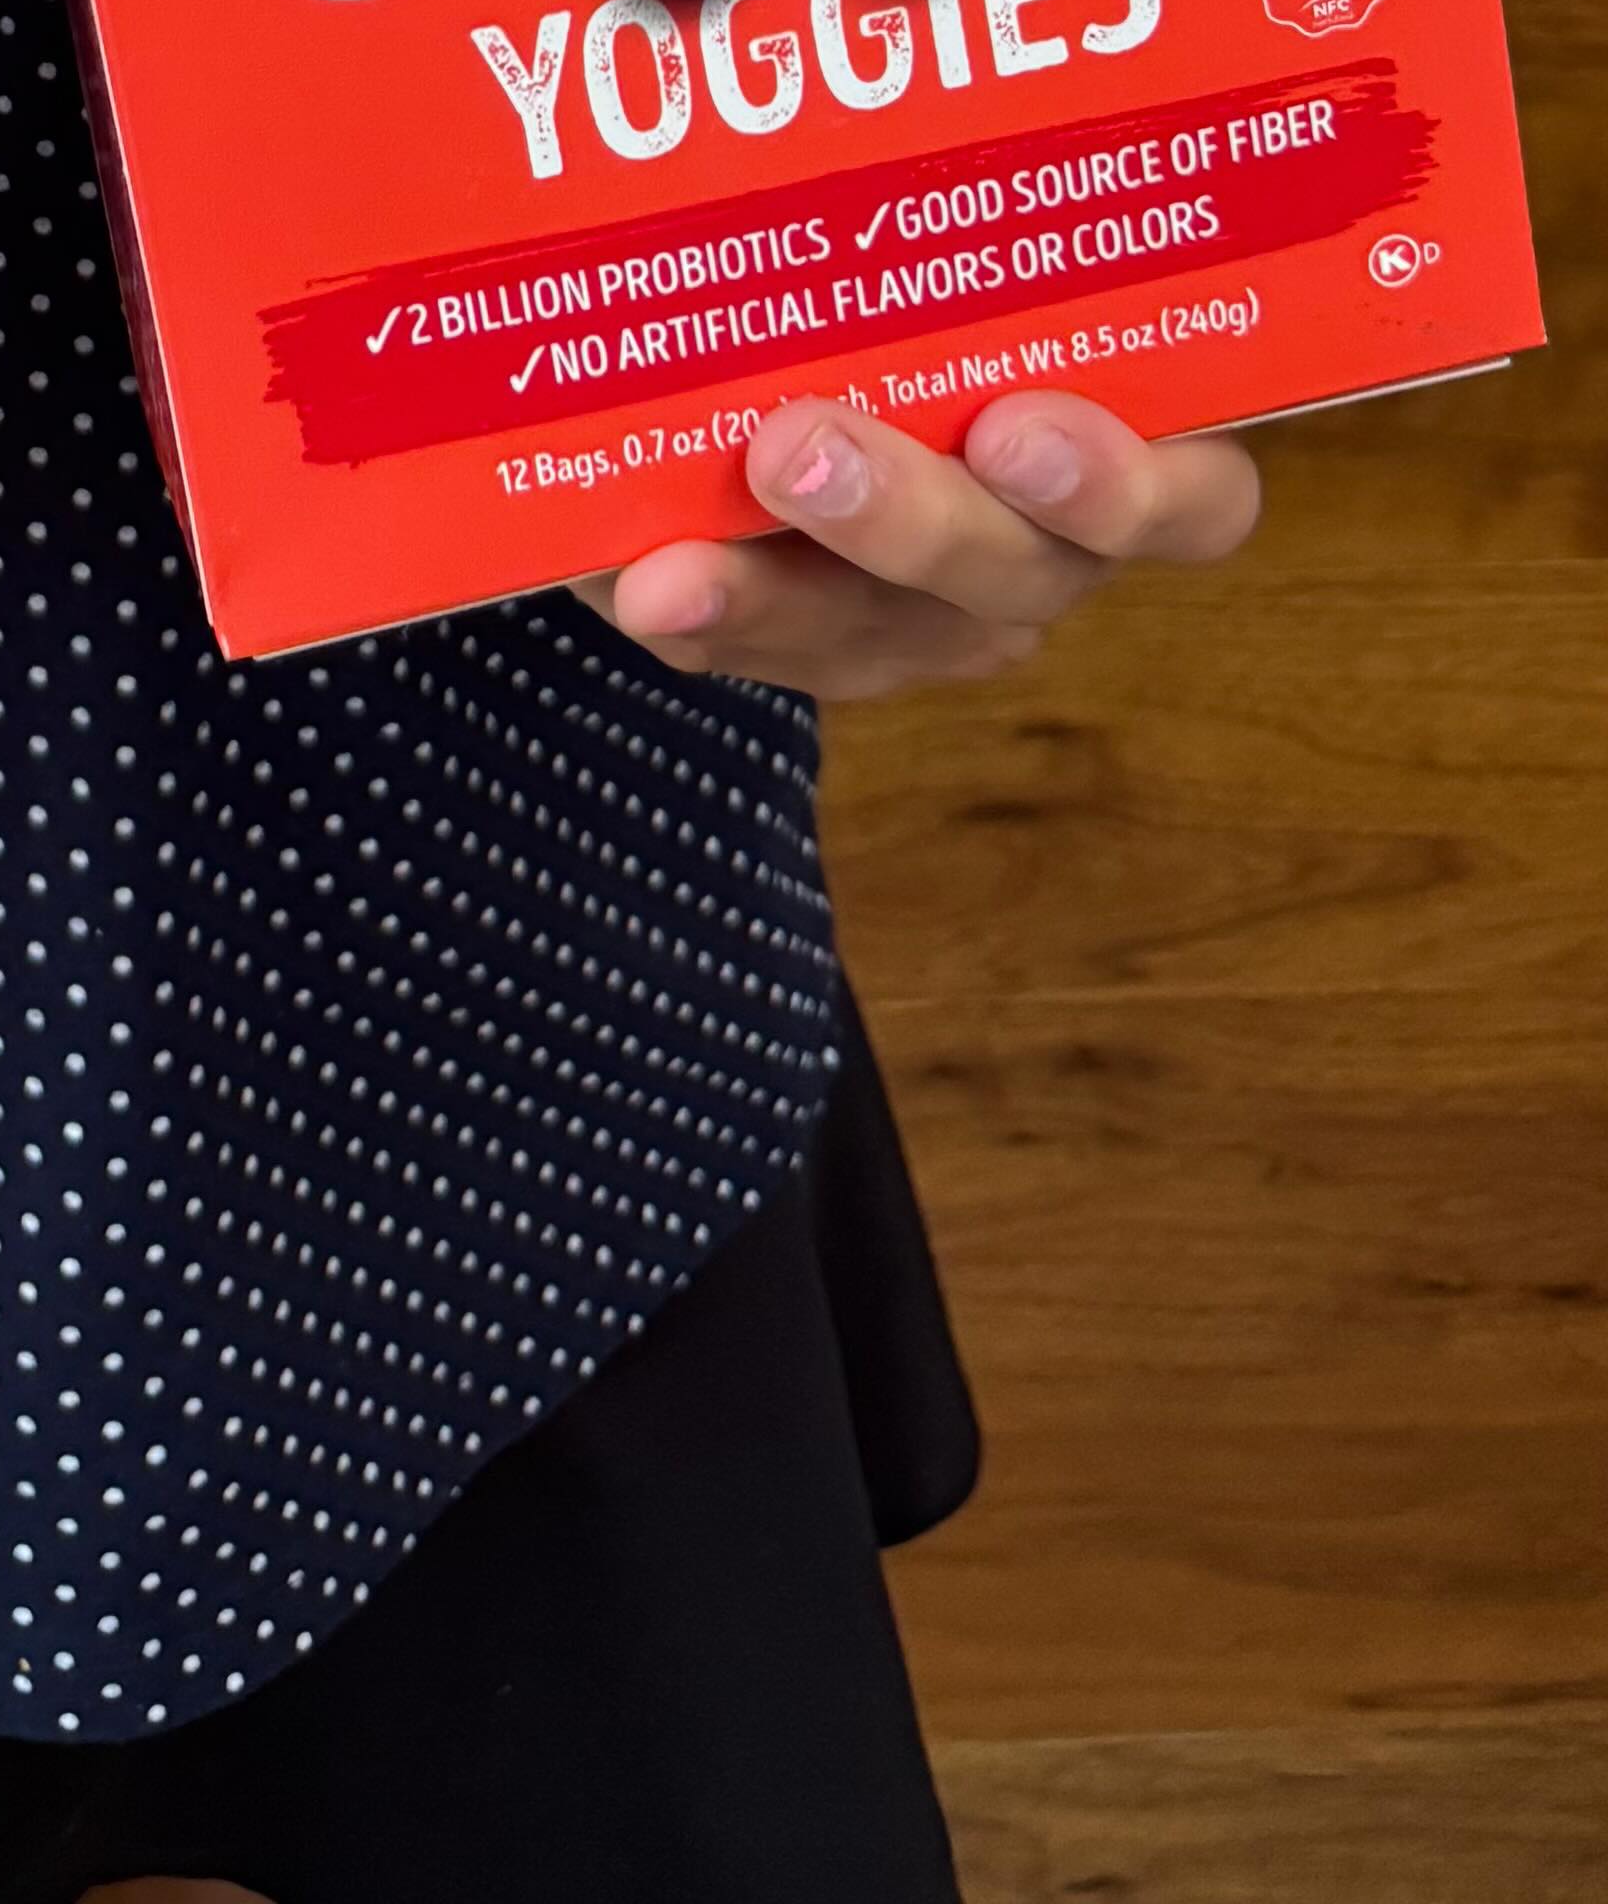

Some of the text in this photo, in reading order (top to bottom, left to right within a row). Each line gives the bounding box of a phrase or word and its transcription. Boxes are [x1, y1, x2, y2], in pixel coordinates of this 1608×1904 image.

[408, 97, 1337, 346] 2 BILLION PROBIOTICS GOOD SOURCE OF FIBER
[550, 194, 1220, 386] NO ARTIFICIAL FLAVORS OR COLORS
[497, 458, 528, 496] 12
[535, 449, 621, 491] Bags,
[622, 427, 666, 469] 0.7
[673, 426, 709, 457] oz
[881, 360, 957, 408] Total
[962, 350, 1014, 392] Net
[1019, 336, 1068, 376] Wt
[1071, 328, 1116, 365] 8.5
[1123, 323, 1155, 352] oz
[1160, 287, 1260, 347] (240g)
